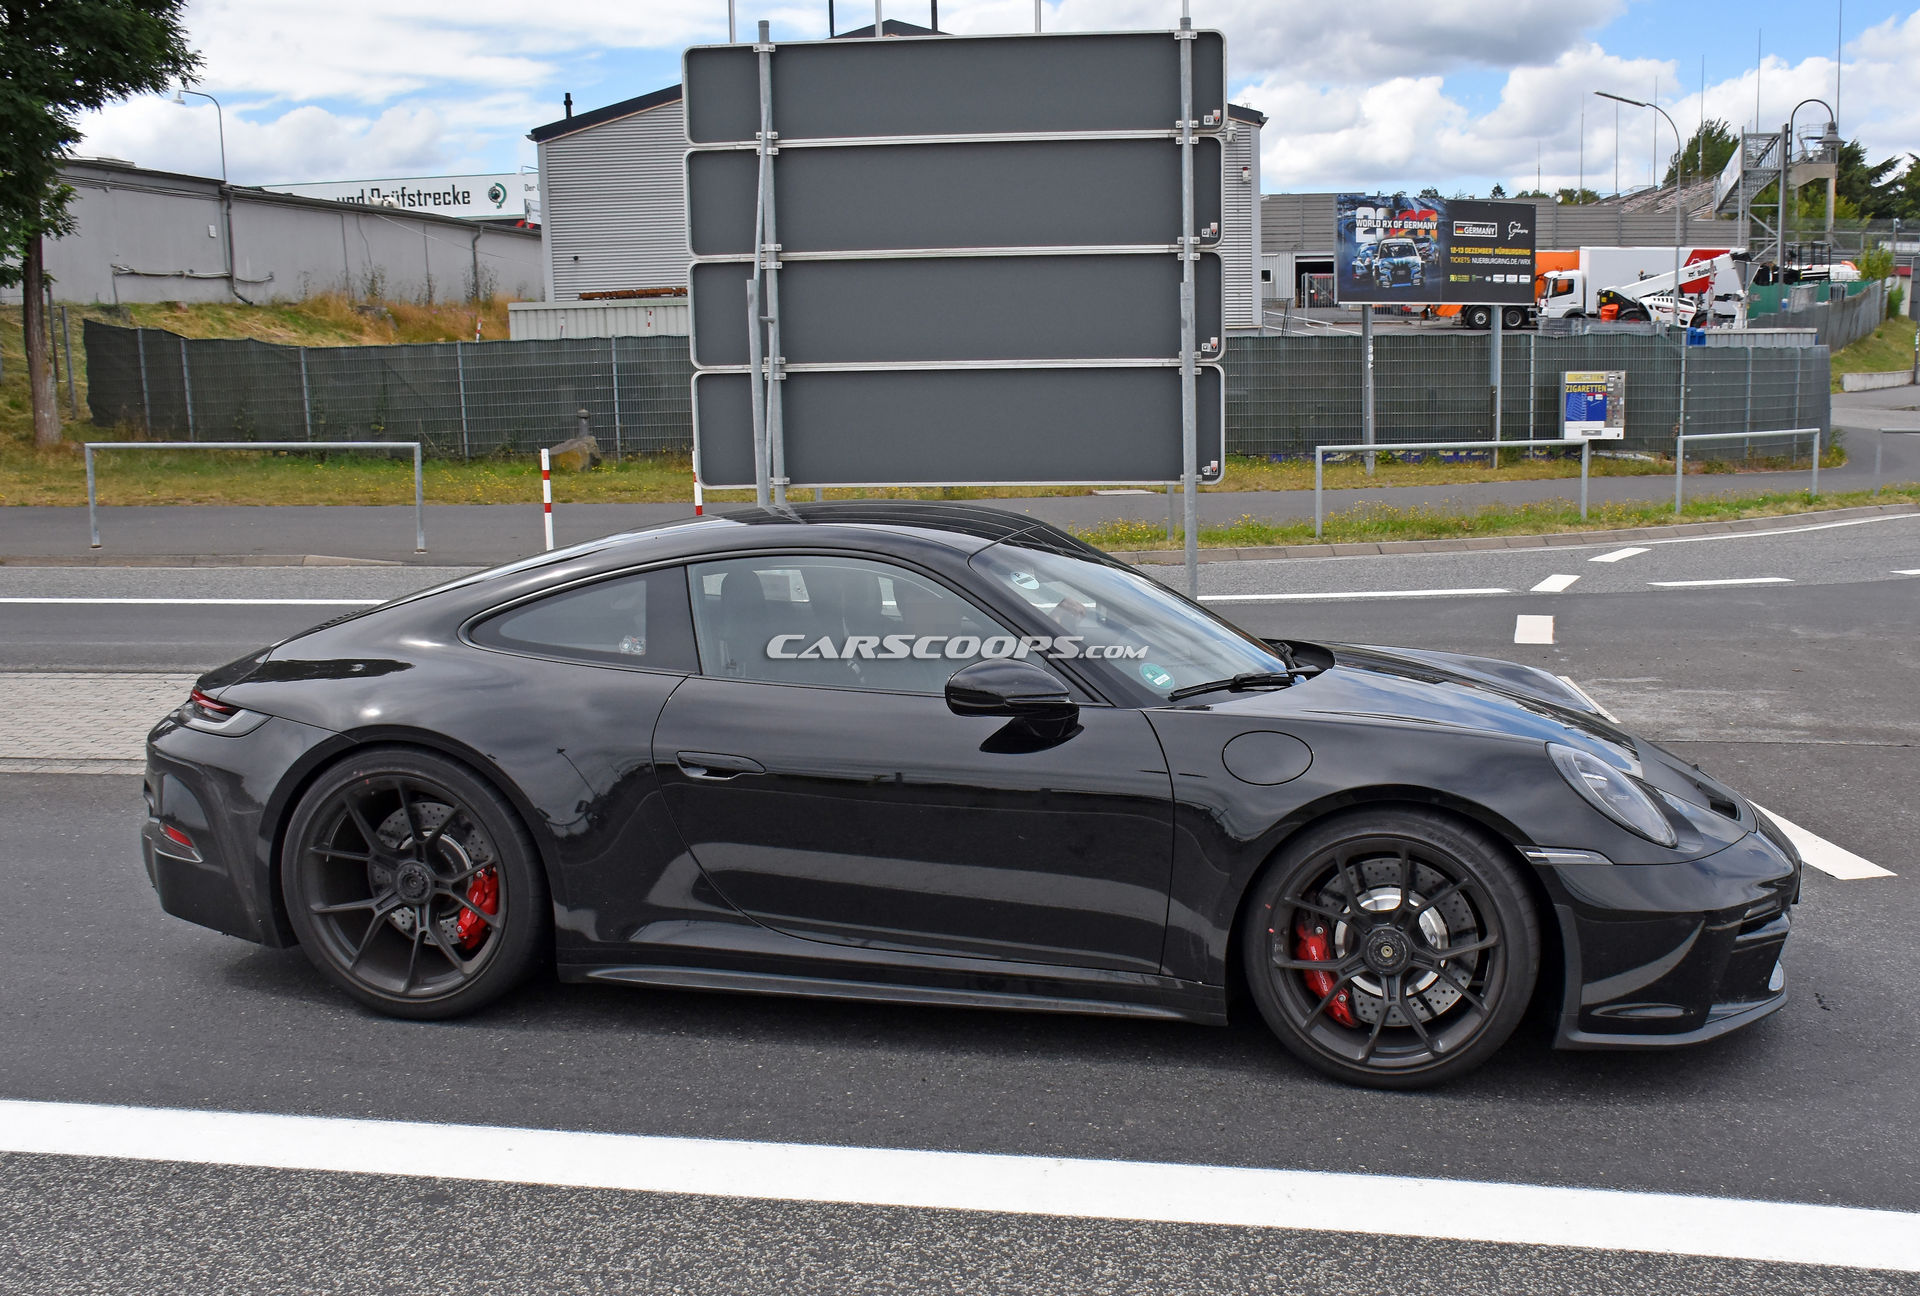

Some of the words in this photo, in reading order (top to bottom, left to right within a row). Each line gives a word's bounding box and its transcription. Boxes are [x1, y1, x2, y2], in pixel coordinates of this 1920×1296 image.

[1356, 219, 1381, 228] WORLD
[1382, 220, 1393, 229] RX
[1393, 220, 1403, 229] OF
[1404, 221, 1438, 230] GERMANY
[1464, 226, 1495, 235] GERMANY
[1565, 384, 1606, 392] ZIGARETTEN
